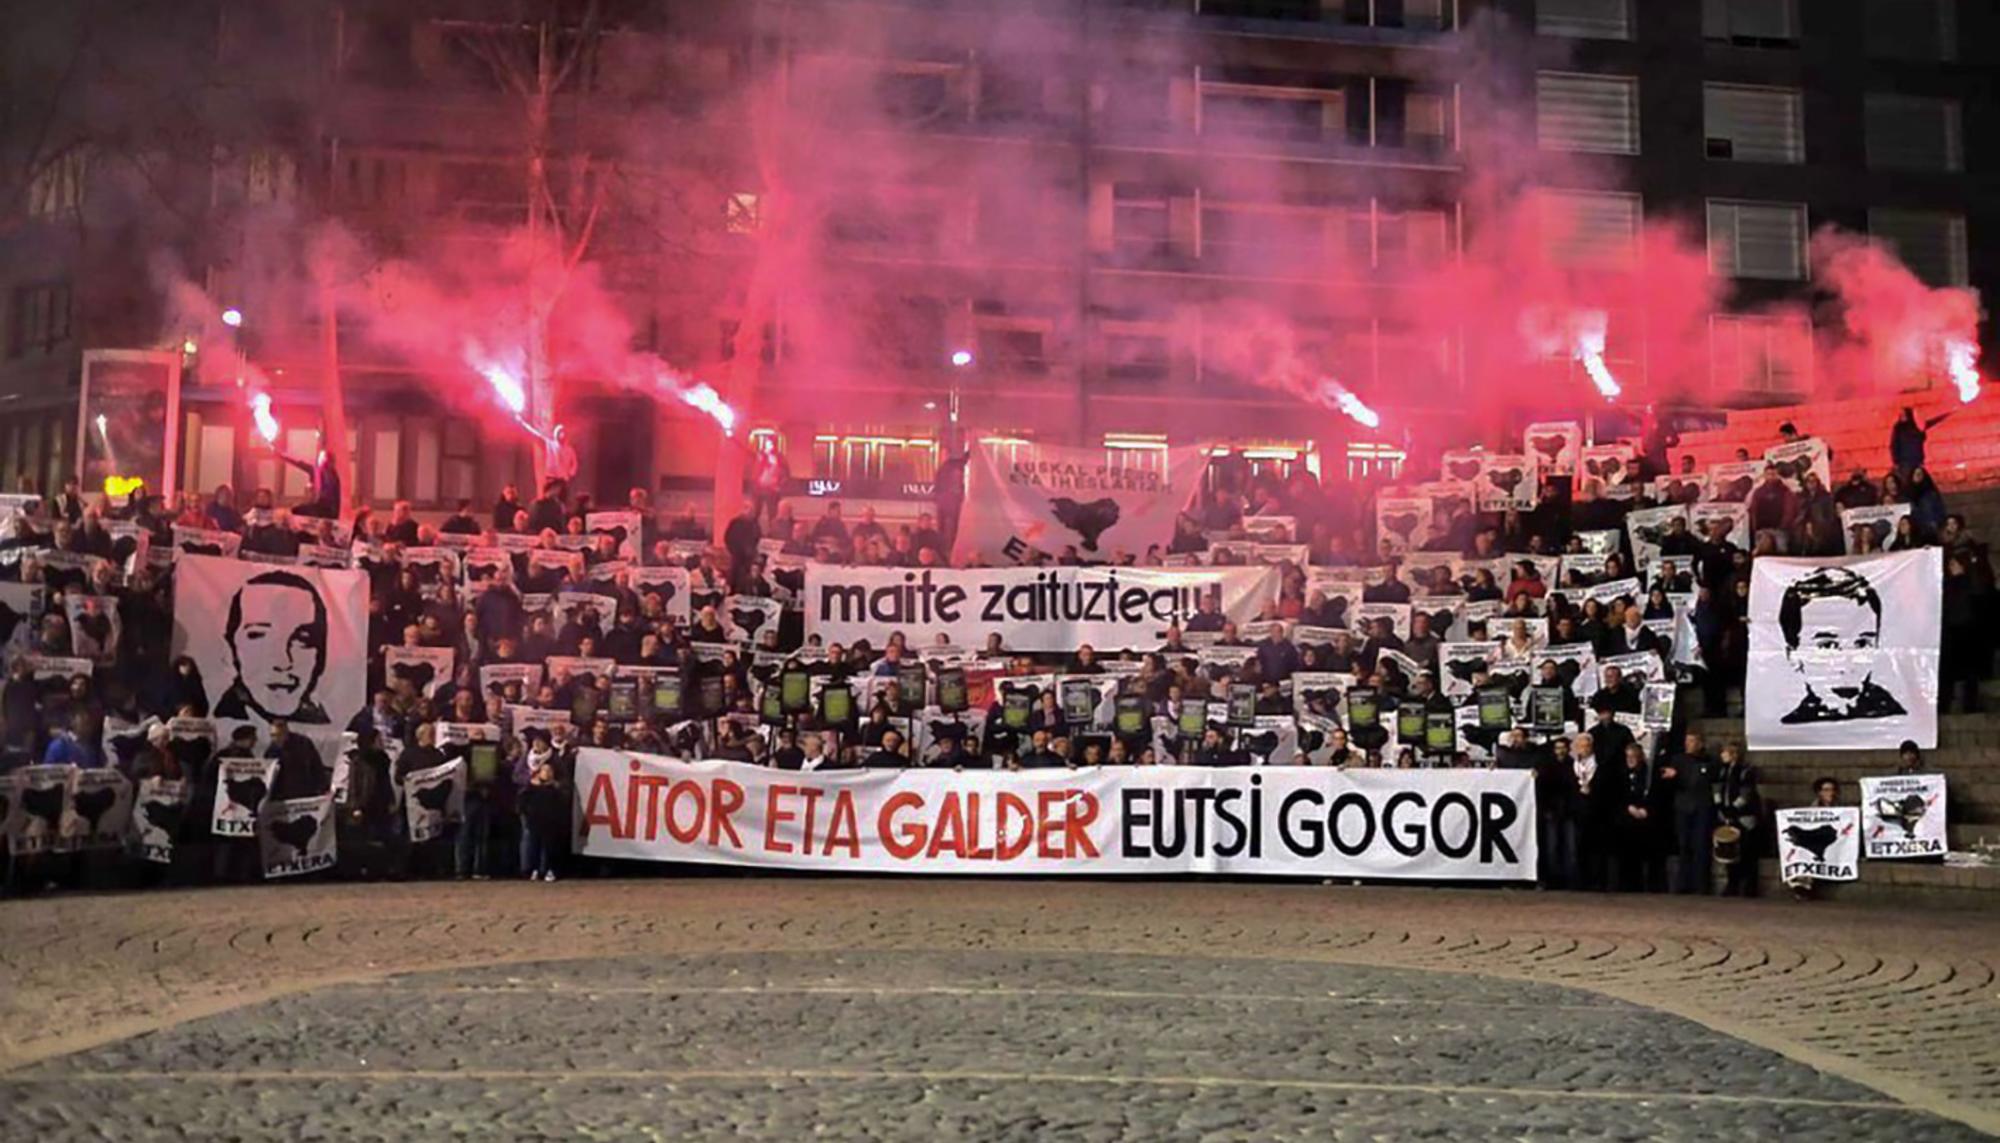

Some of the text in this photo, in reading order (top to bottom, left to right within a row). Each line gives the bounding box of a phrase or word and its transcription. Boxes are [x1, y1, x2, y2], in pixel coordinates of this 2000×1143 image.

[1013, 462, 1089, 477] EUSKAL
[820, 570, 968, 625] maite
[764, 784, 861, 859] ETA
[876, 789, 1101, 860] GALDER
[1278, 789, 1519, 863] GOGOR
[1871, 839, 1942, 855] ETXERA
[1785, 862, 1853, 878] ETXERA
